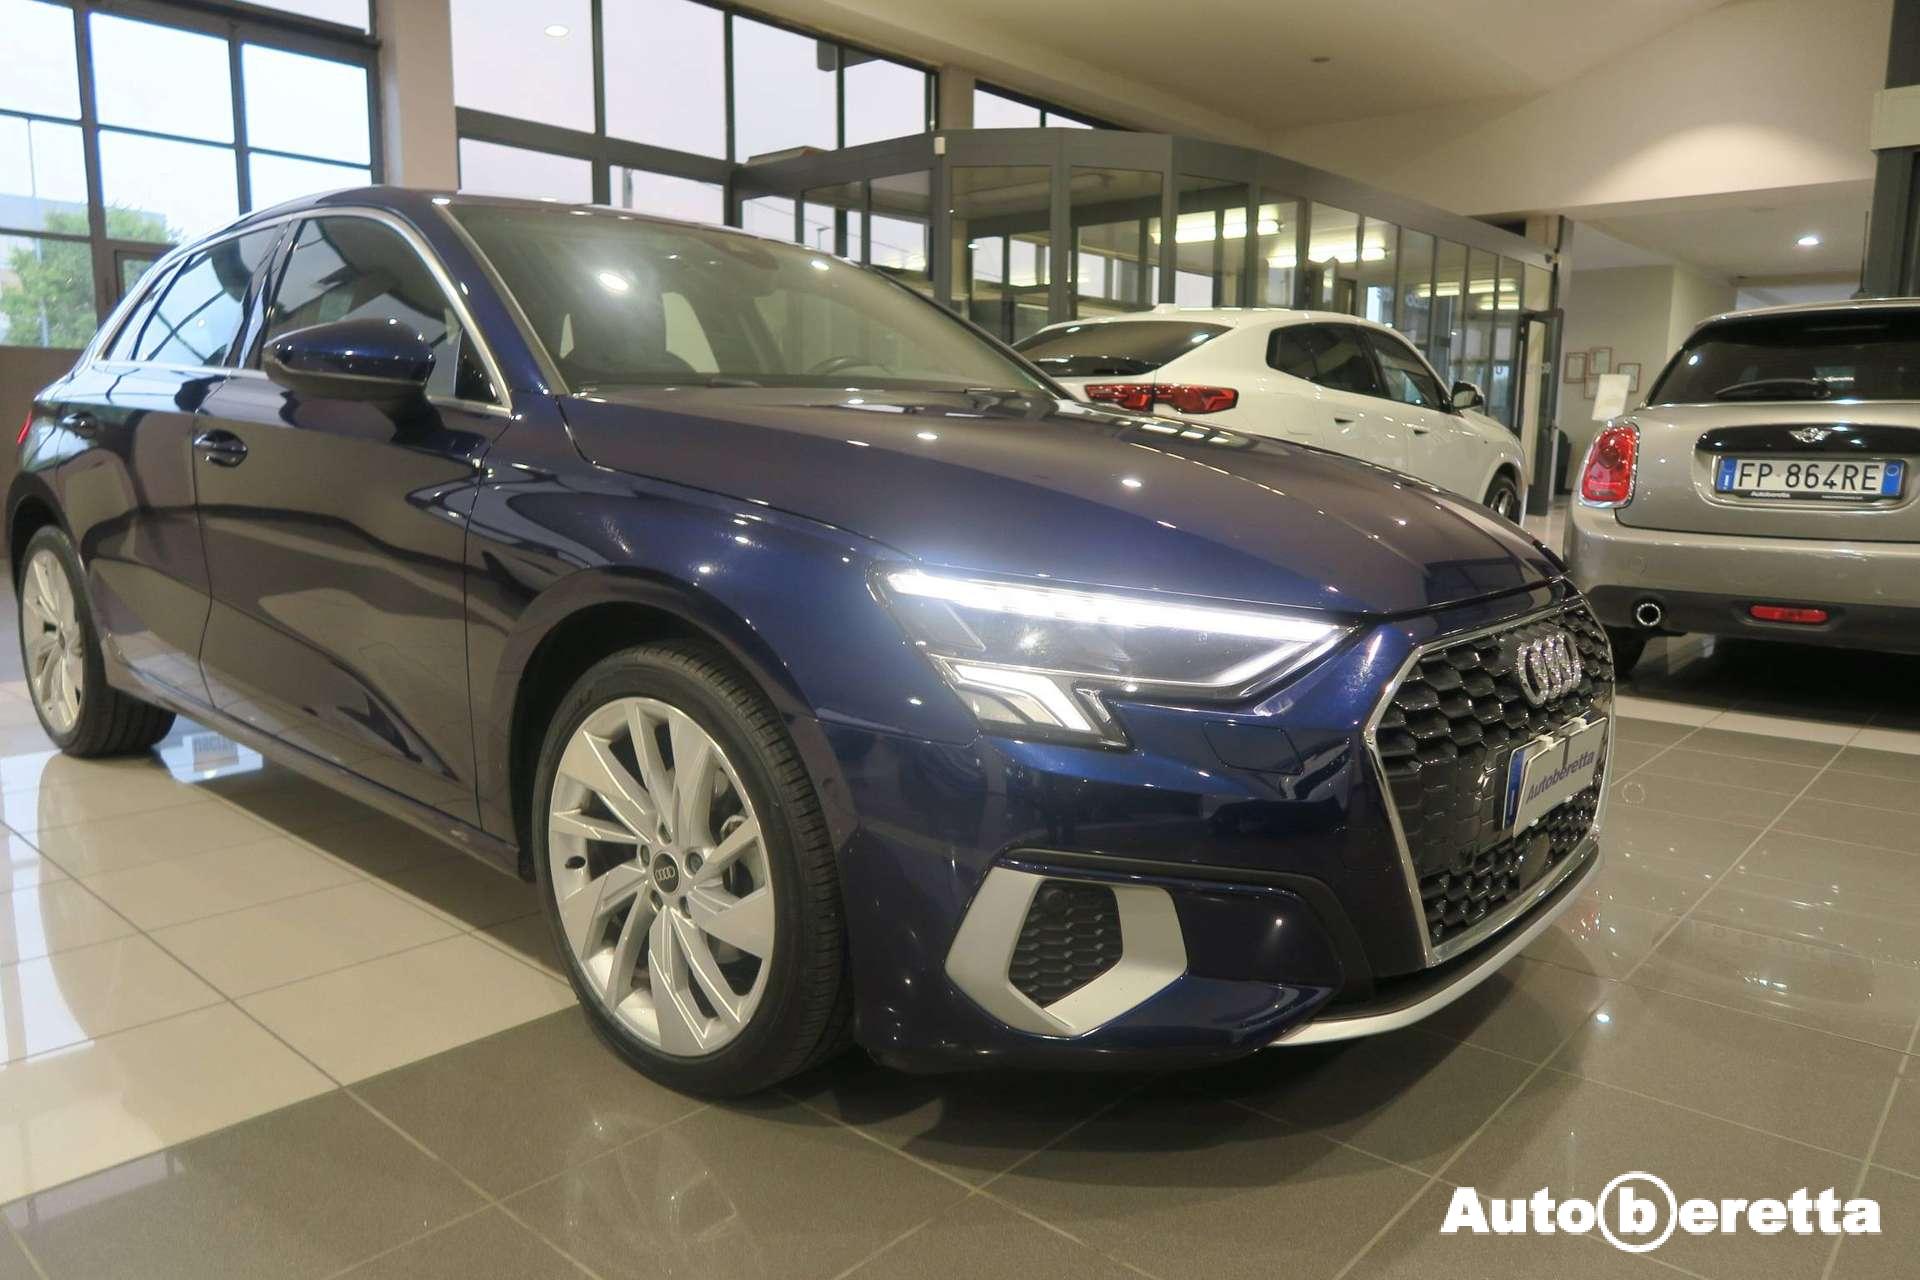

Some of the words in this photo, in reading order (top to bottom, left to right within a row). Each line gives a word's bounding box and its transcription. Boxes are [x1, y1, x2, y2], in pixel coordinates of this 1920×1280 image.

[1738, 463, 1773, 487] FP
[1785, 463, 1880, 491] 864RE
[1527, 751, 1595, 802] Autoberetta
